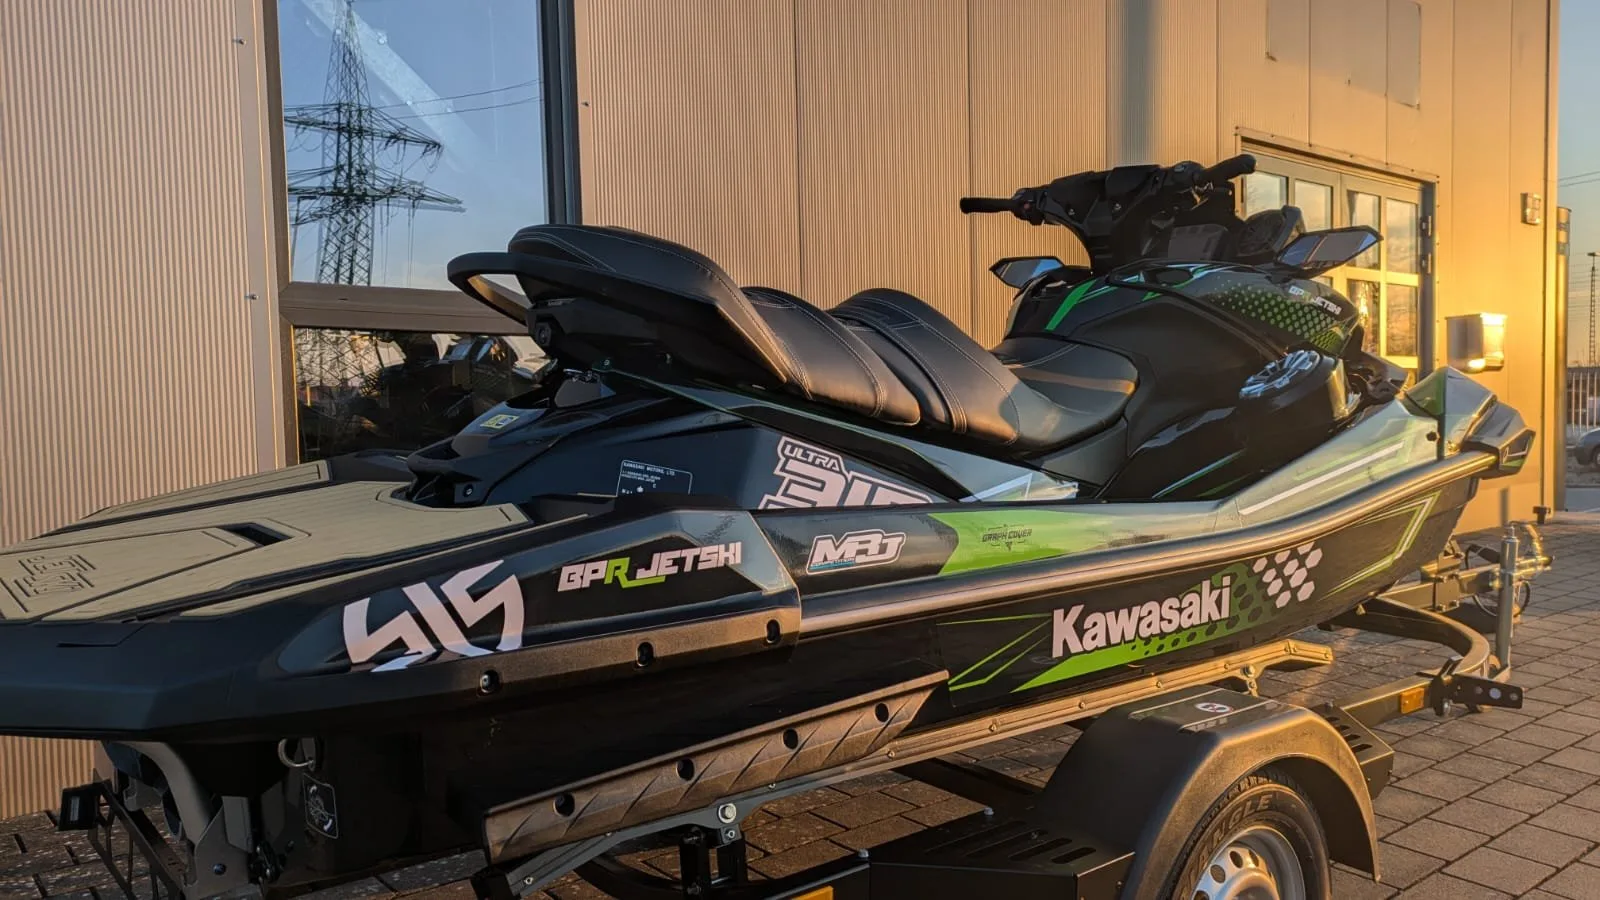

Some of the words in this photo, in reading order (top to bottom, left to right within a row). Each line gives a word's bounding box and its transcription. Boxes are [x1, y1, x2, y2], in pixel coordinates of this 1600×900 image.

[784, 444, 840, 472] ULTRA
[558, 557, 632, 592] BPR
[636, 542, 741, 580] JETSKI
[1052, 575, 1231, 658] Kawasaki
